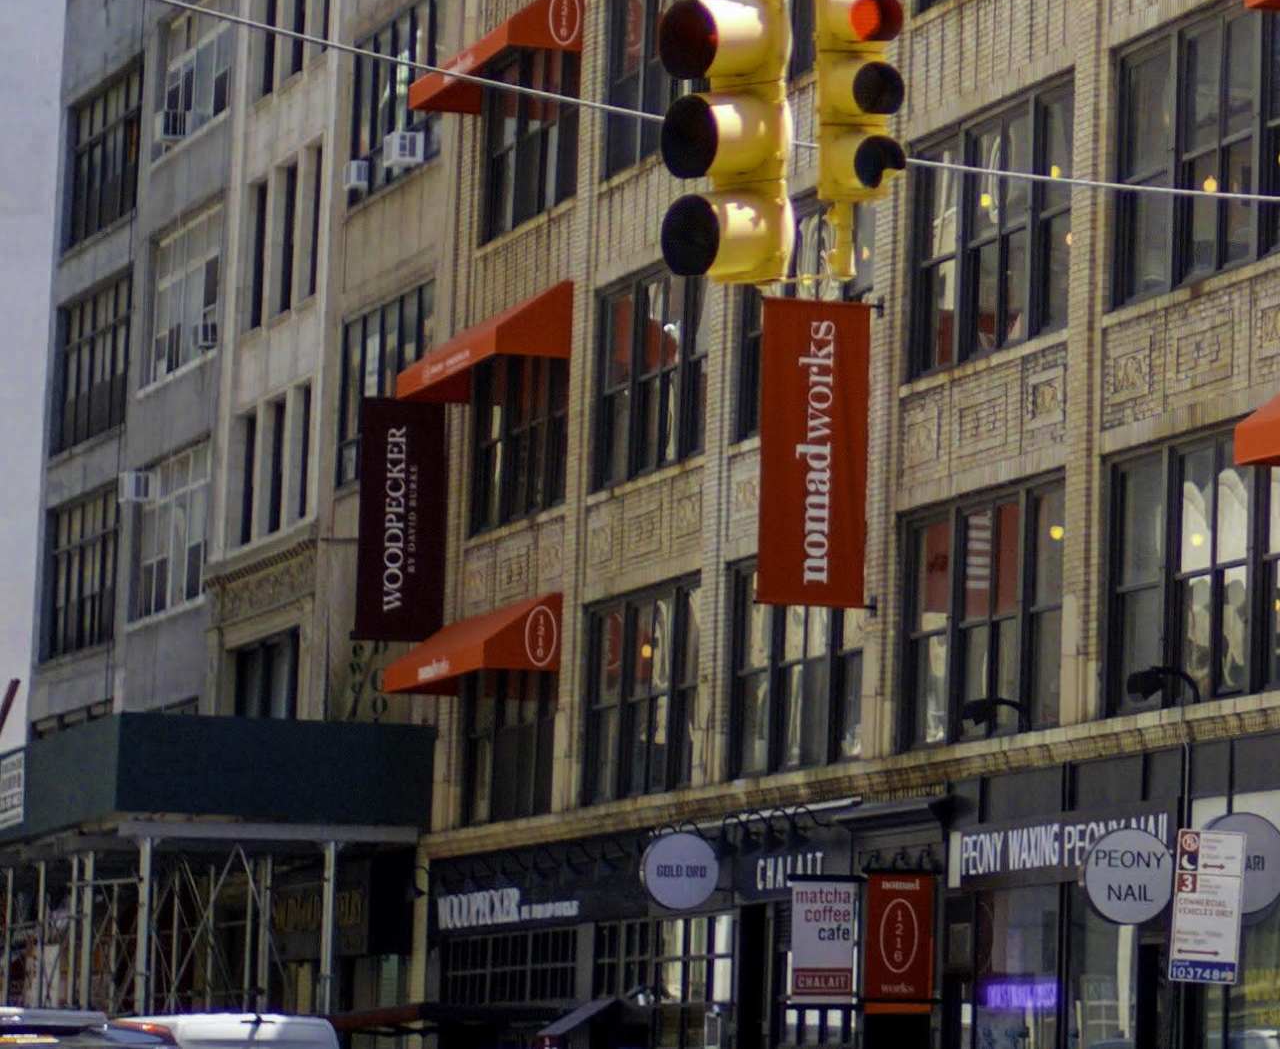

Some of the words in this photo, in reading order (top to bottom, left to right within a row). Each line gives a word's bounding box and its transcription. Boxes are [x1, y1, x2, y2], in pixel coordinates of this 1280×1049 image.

[796, 320, 836, 585] nomadworks
[382, 425, 407, 612] WOODPECKER
[962, 831, 1004, 875] PEONY
[1008, 822, 1060, 871] WAXING
[1095, 849, 1166, 869] PEONY
[1244, 854, 1265, 872] ARI
[881, 878, 921, 891] nomad
[1182, 873, 1193, 893] 3
[795, 887, 850, 903] matcha
[1107, 884, 1154, 902] NAIL
[804, 906, 850, 923] coffee
[818, 924, 850, 941] cafe
[893, 909, 905, 962] 1216
